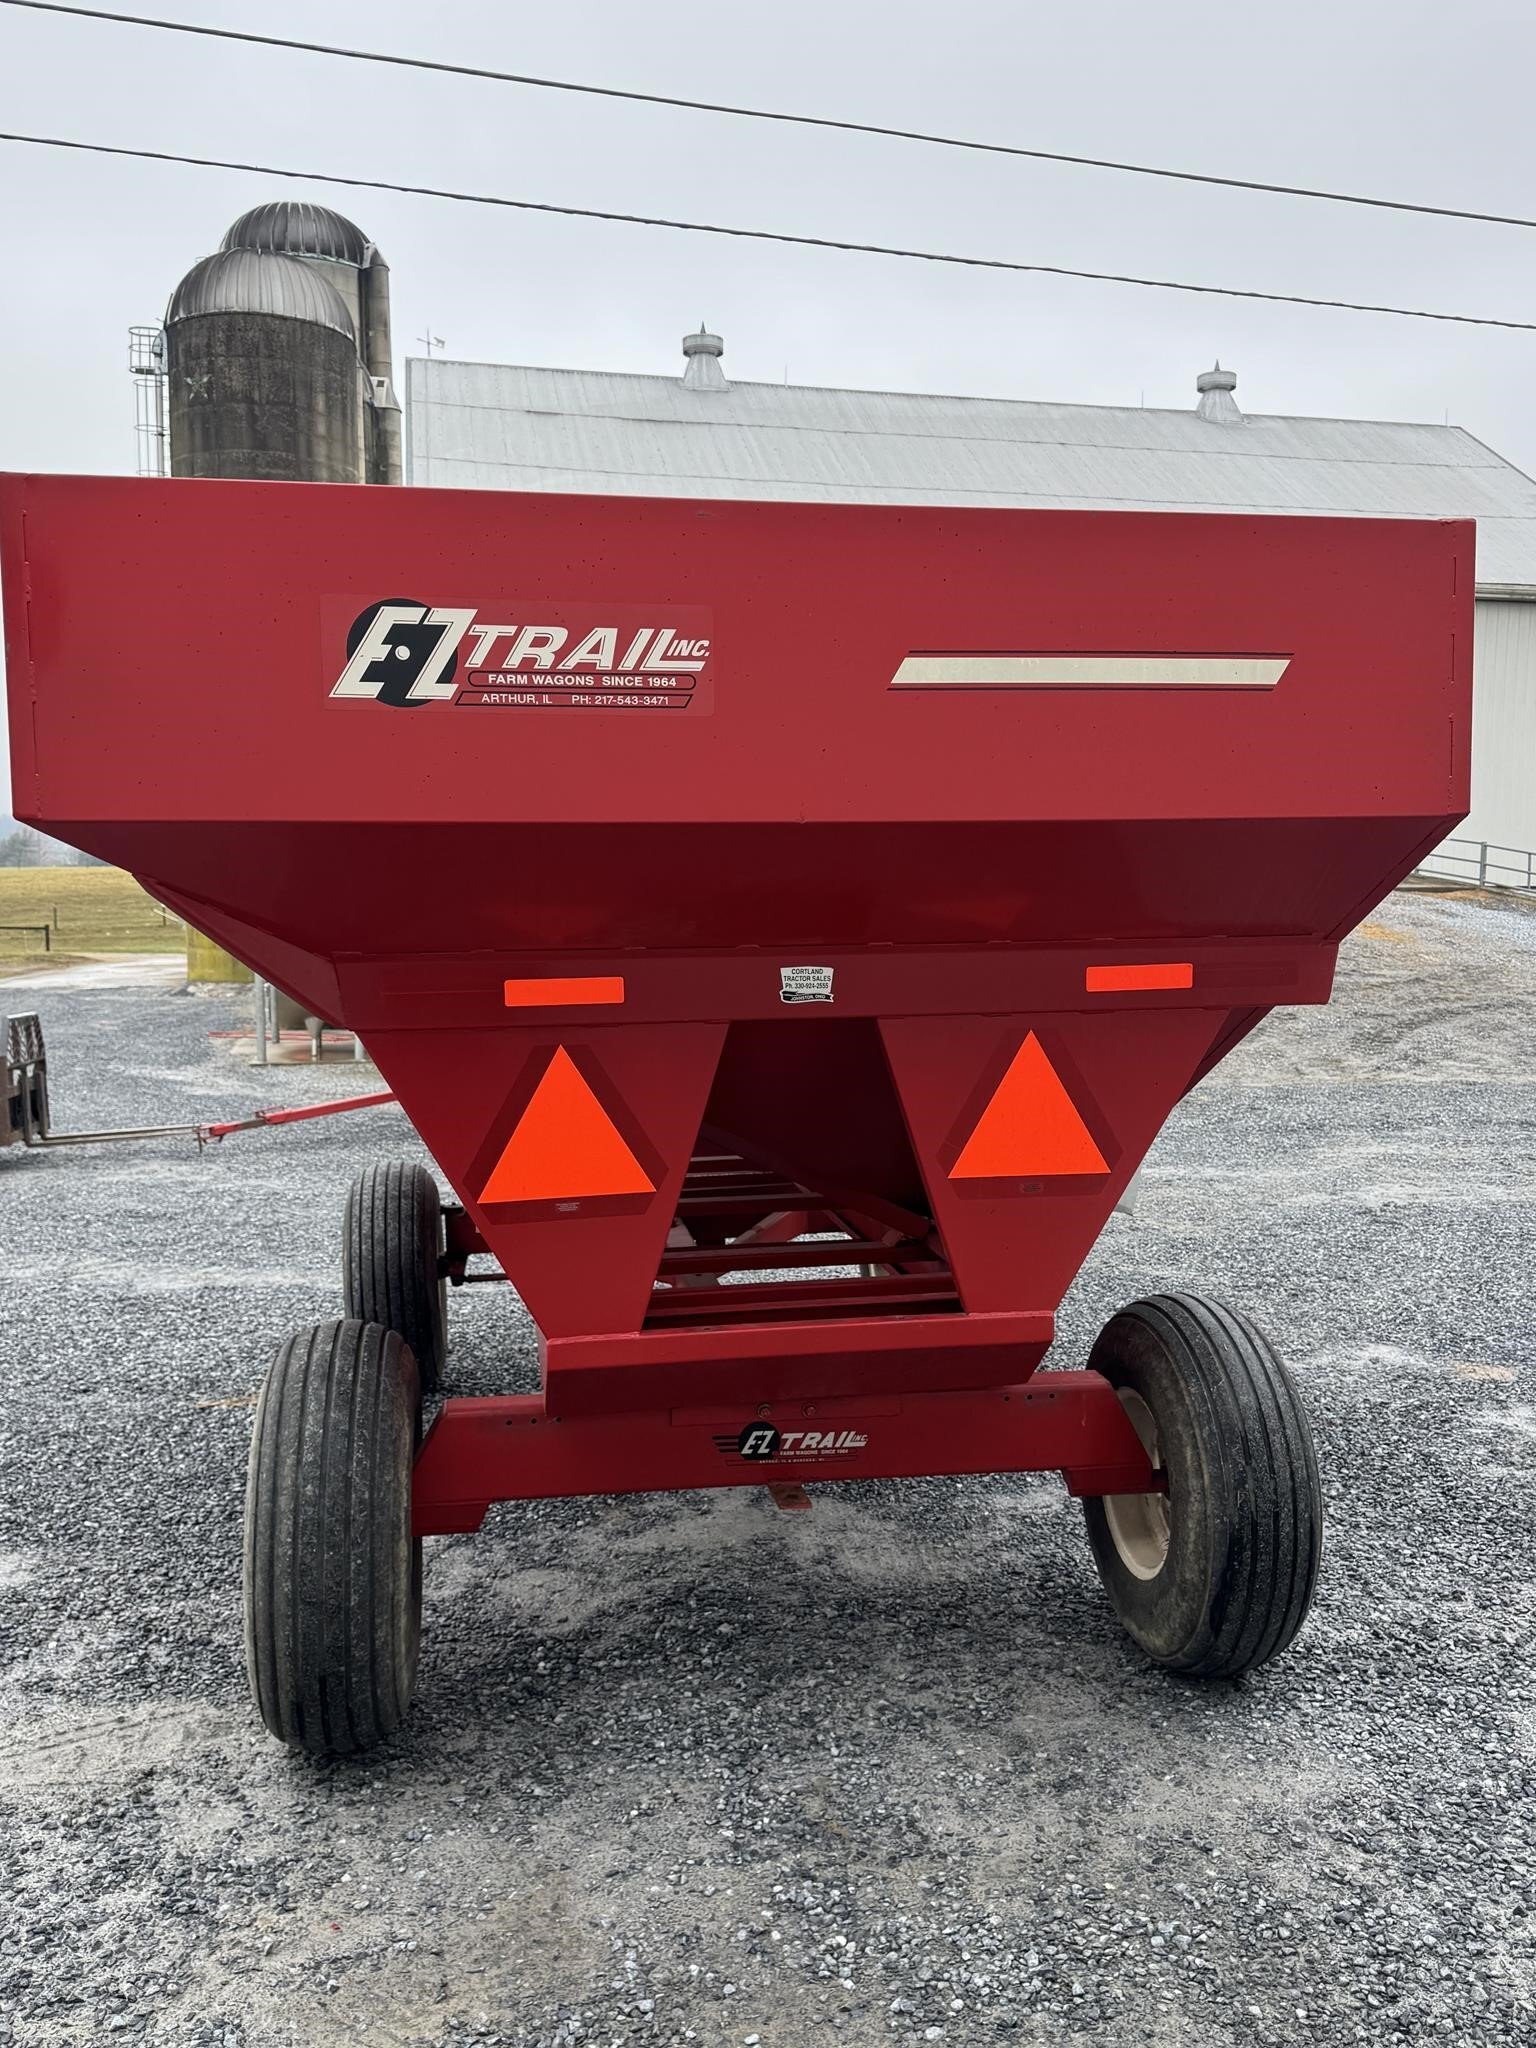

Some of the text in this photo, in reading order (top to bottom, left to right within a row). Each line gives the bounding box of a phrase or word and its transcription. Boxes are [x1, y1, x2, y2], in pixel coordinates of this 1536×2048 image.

[464, 625, 707, 673] TRAIL
[667, 639, 711, 658] INC.
[488, 674, 677, 687] FARM WAGONS SINCE 1964
[481, 693, 670, 705] ARTHUR, IL PH: 217-543-3471
[780, 1431, 867, 1449] TRAIL
